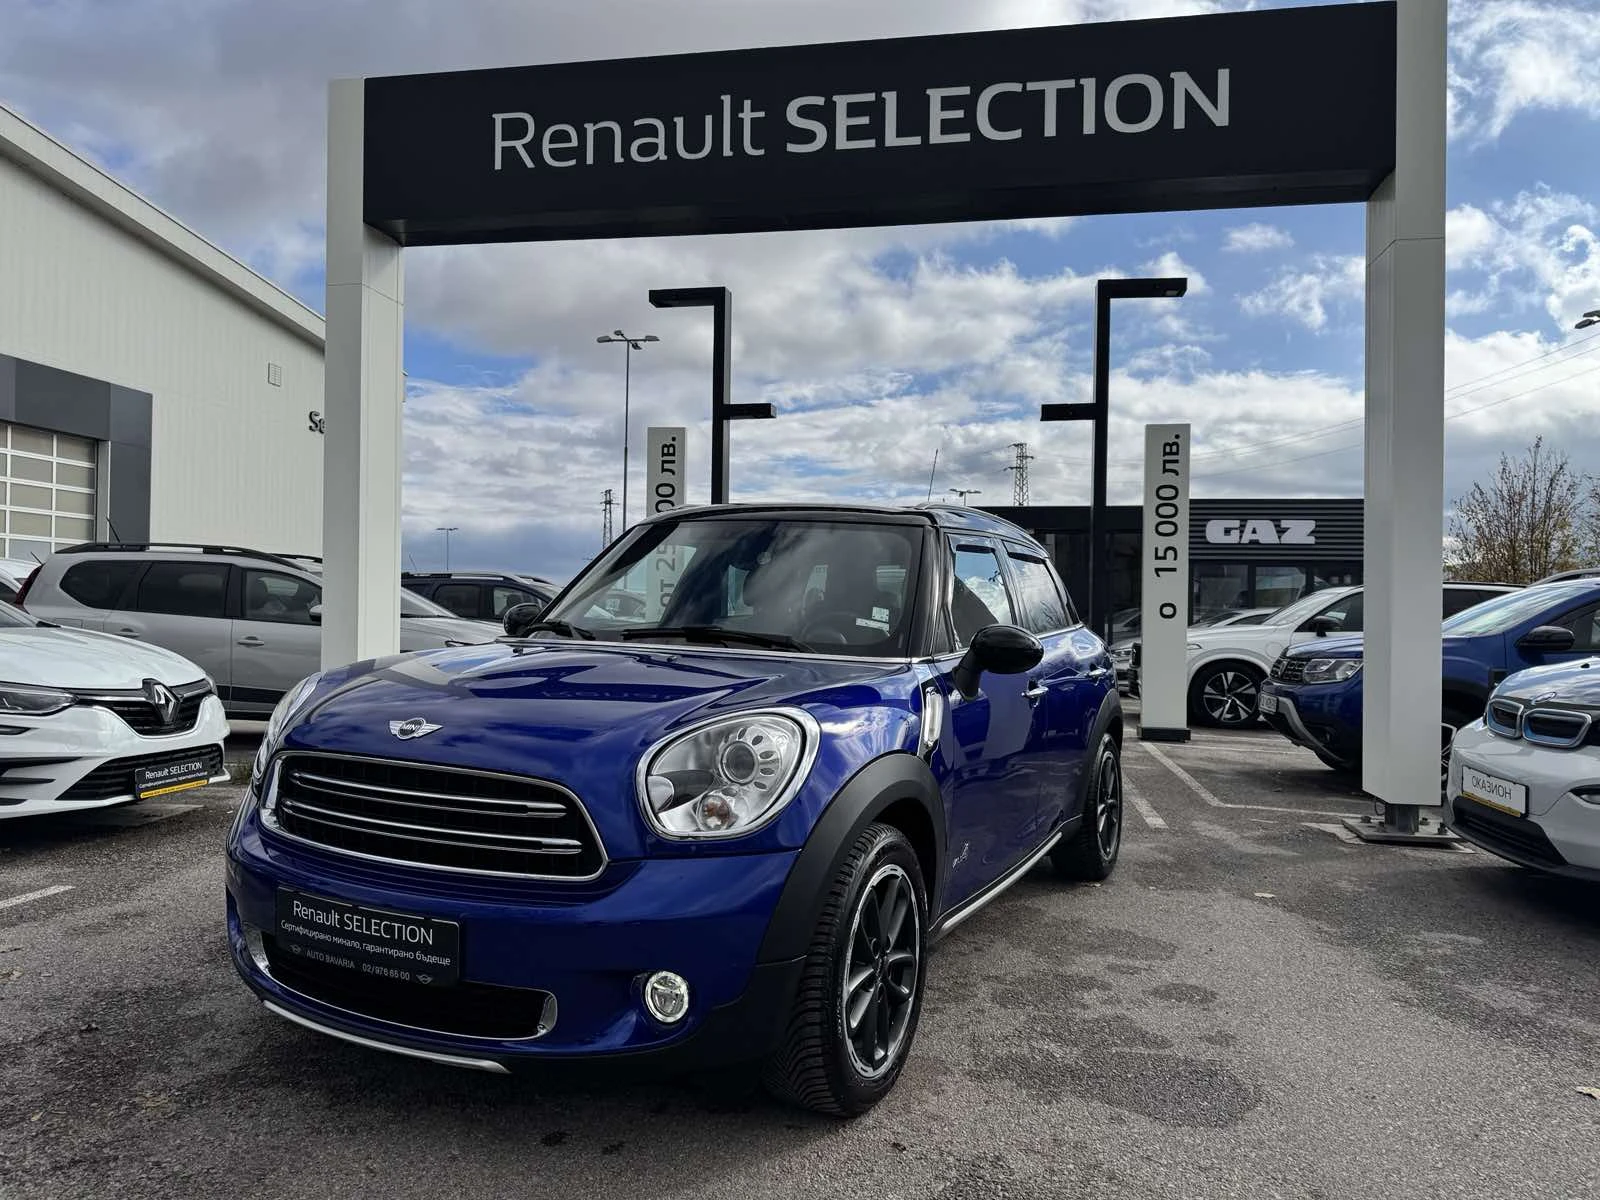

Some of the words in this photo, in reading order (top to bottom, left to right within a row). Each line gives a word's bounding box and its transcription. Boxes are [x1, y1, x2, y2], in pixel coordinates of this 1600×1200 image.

[492, 95, 765, 170] Renault
[785, 68, 1230, 154] SELECTION
[309, 411, 327, 434] Se
[661, 436, 676, 476] лв.
[1162, 434, 1180, 476] лв.
[655, 482, 676, 515] 00
[1154, 484, 1179, 537] 000
[1205, 519, 1316, 545] GAZ
[1154, 545, 1178, 578] 15
[145, 768, 169, 780] Renault
[170, 761, 203, 776] SELECTION
[1471, 775, 1512, 801] ОКАЗИОН
[293, 900, 340, 928] Renault
[344, 913, 433, 945] SELECTION
[280, 919, 332, 942] Сертифицирано
[362, 943, 415, 959] гарантирано
[415, 950, 451, 967] бъдеще
[306, 950, 325, 962] AUTO
[325, 954, 355, 969] BAVARIA
